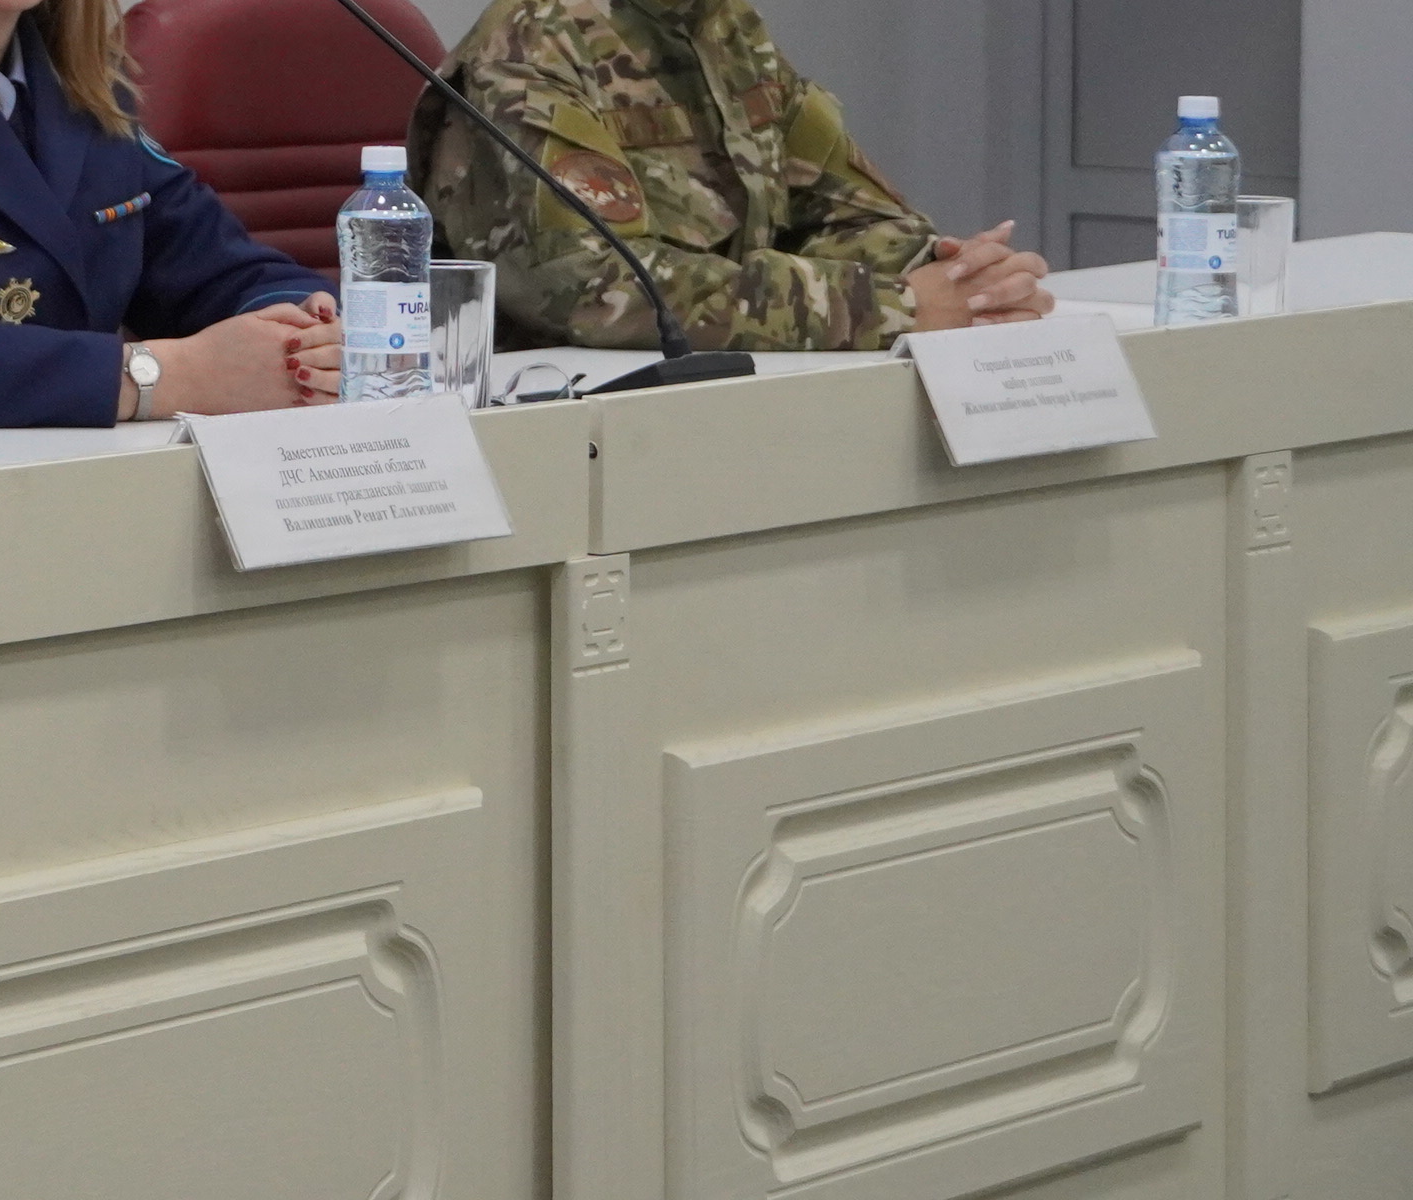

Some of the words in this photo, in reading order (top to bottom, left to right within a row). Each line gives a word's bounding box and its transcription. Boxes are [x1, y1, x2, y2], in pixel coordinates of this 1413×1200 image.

[277, 445, 348, 462] Заместитель
[350, 438, 410, 453] начальника
[279, 469, 306, 487] ДЧС
[309, 461, 383, 482] Акмолинской
[385, 459, 426, 473] области
[275, 493, 335, 510] полковник
[336, 481, 406, 505] гражданской
[408, 480, 448, 493] защиты
[353, 509, 388, 523] Ренат
